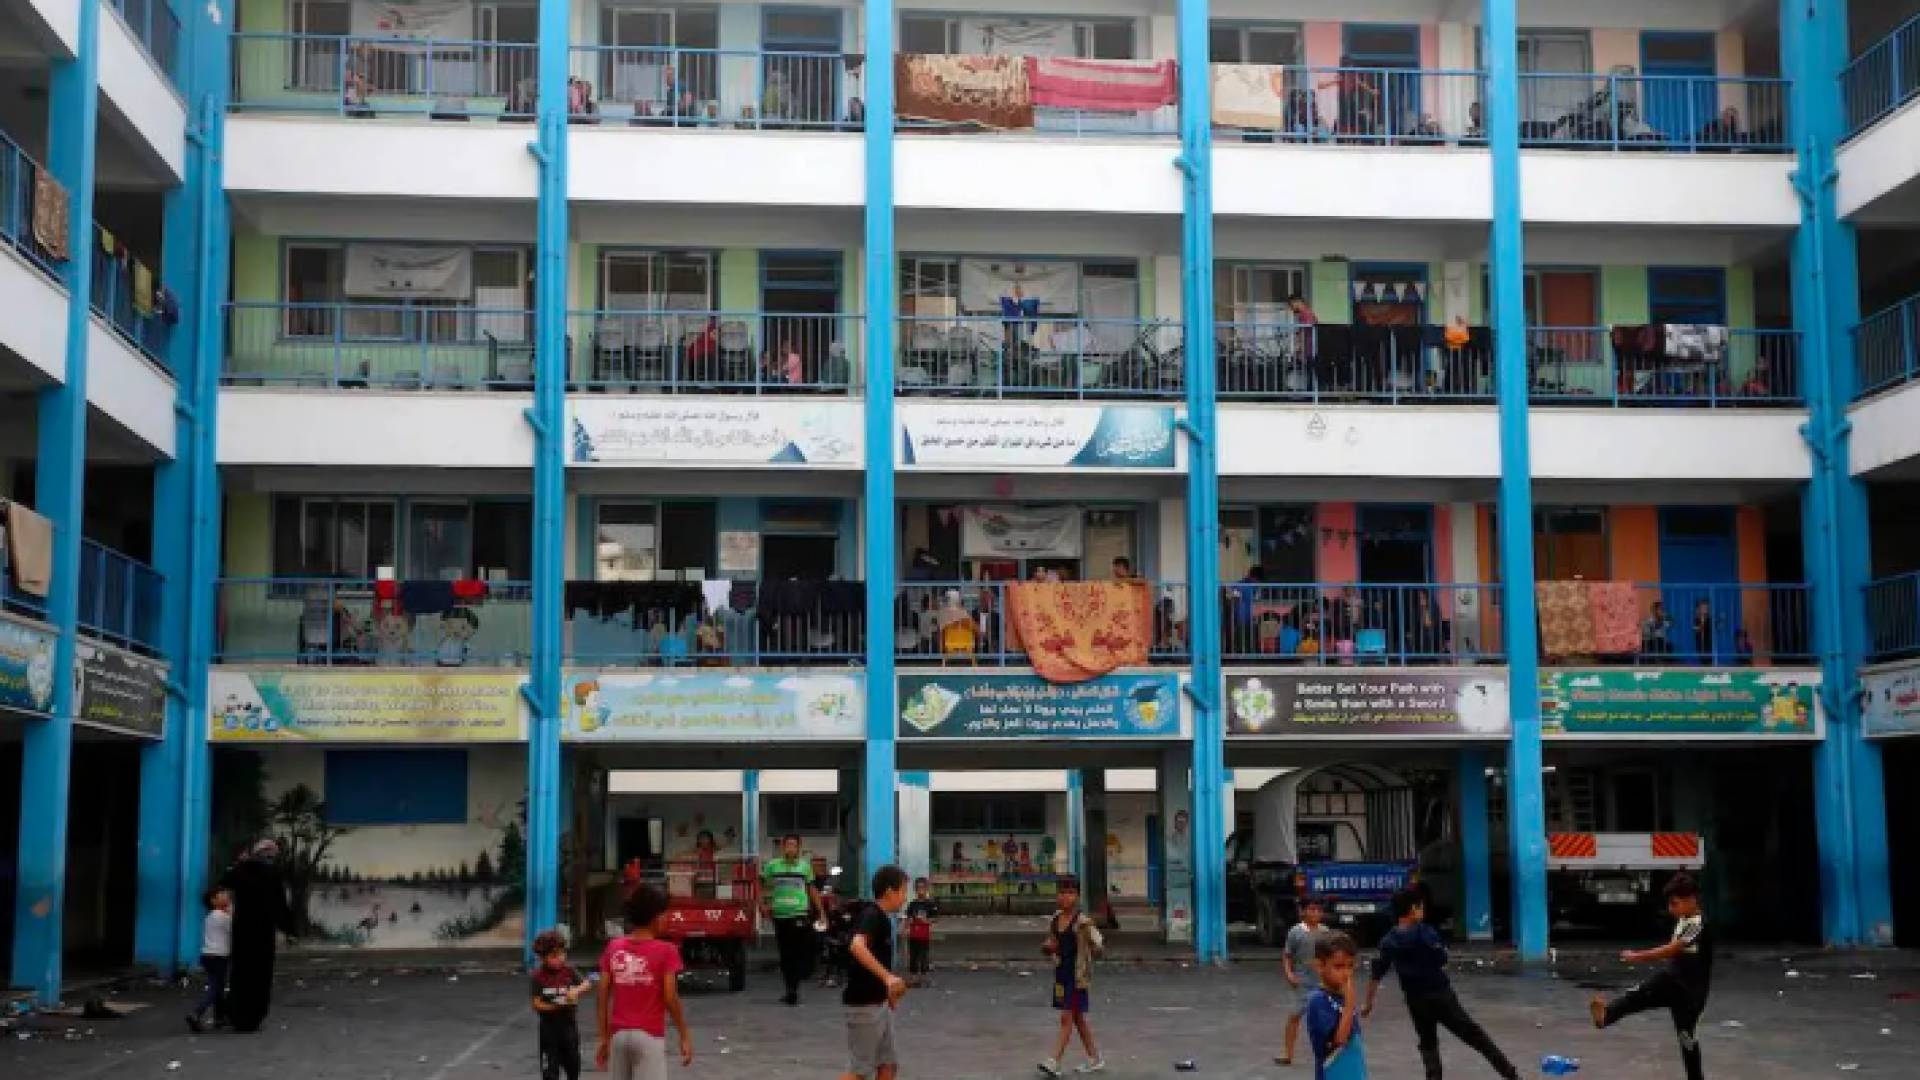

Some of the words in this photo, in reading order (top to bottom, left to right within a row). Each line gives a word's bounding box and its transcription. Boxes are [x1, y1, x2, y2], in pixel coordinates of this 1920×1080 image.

[1297, 682, 1333, 695] Better
[1358, 682, 1388, 695] Your
[1390, 682, 1418, 695] Path
[1420, 682, 1445, 695] with
[1304, 697, 1338, 709] Smile
[1341, 697, 1367, 709] than
[1369, 697, 1394, 709] with
[1313, 874, 1402, 891] MITSUBISHI
